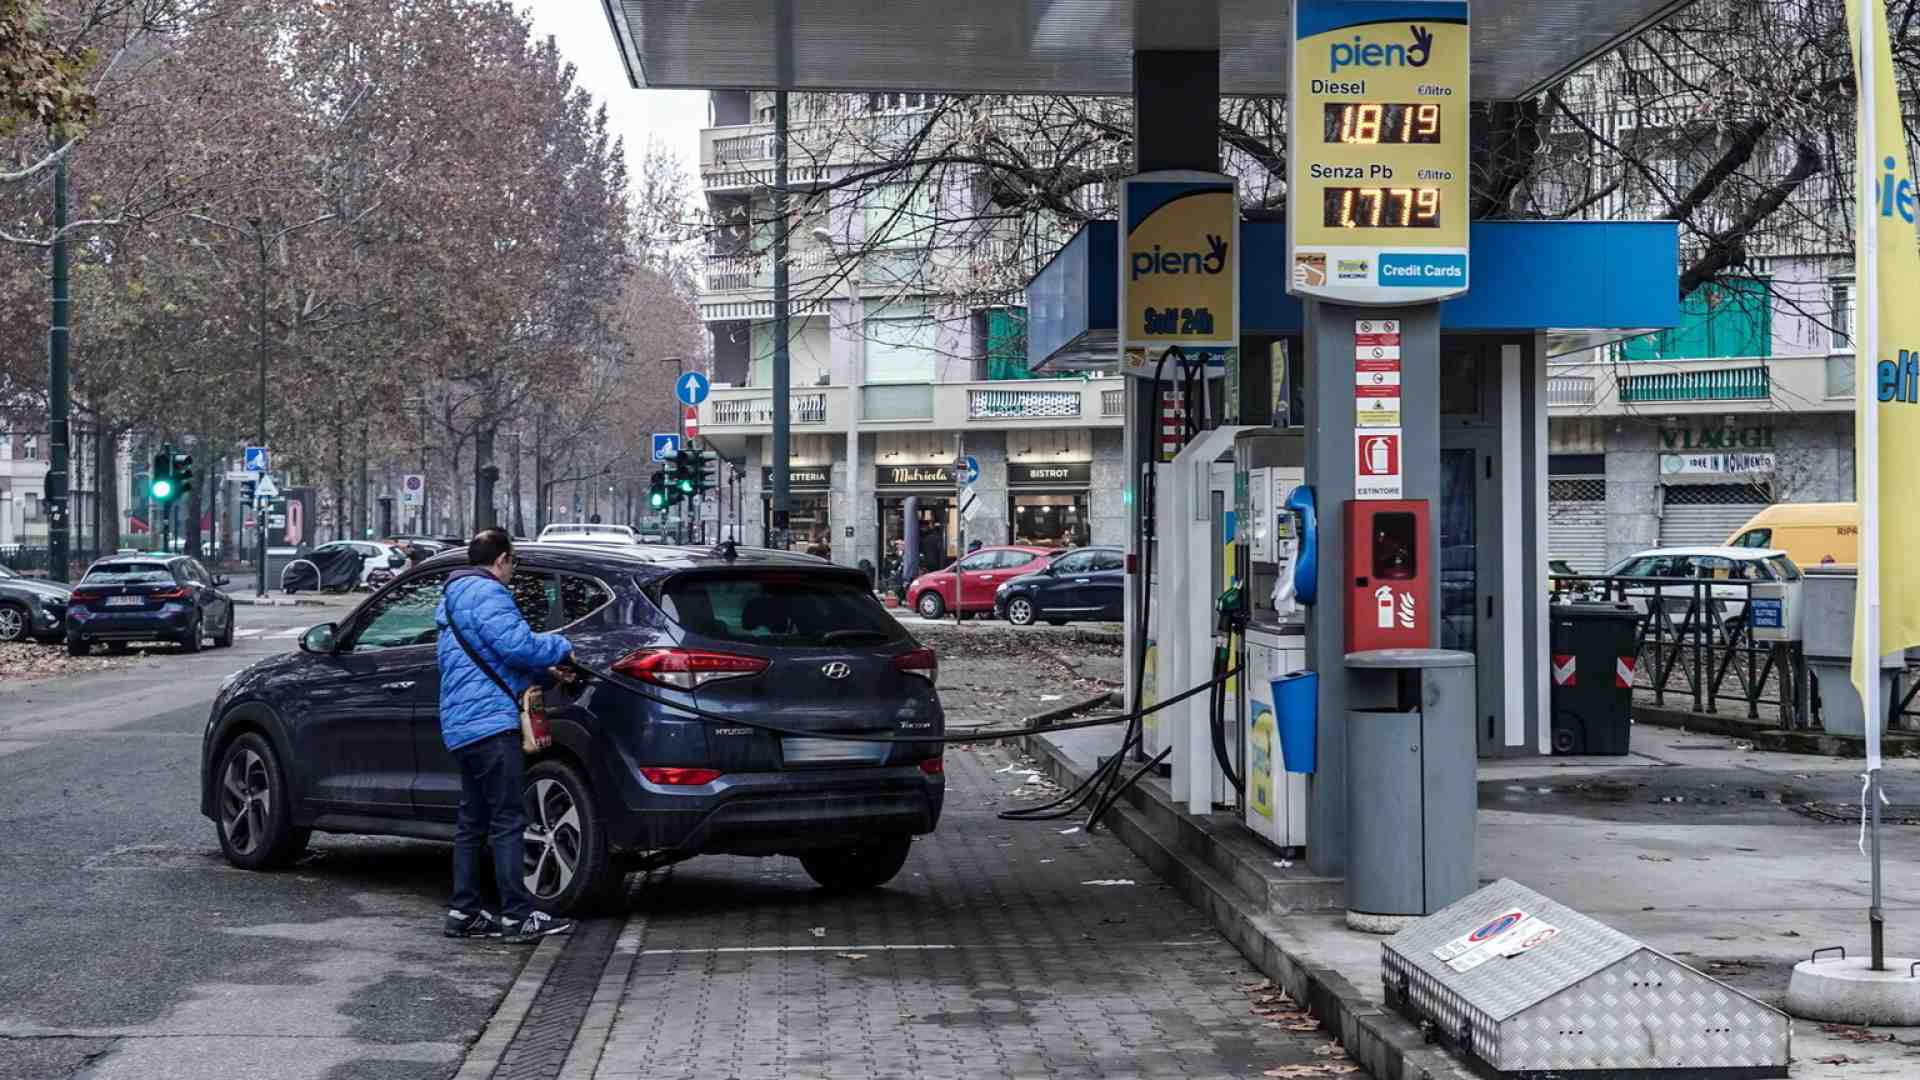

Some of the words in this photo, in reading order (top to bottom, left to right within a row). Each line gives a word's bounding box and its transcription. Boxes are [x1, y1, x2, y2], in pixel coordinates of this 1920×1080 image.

[1330, 27, 1432, 73] pieno
[1311, 80, 1365, 95] Diesel
[1310, 164, 1364, 179] Senza
[1370, 164, 1393, 179] Pb
[1876, 156, 1914, 223] ie
[1131, 235, 1228, 281] pieno
[1383, 264, 1421, 276] Credit
[1424, 264, 1462, 276] Cards
[1877, 349, 1919, 403] elf
[1660, 426, 1775, 449] VIAGGI
[891, 468, 948, 483] Matricola
[1029, 469, 1069, 478] BISTROT
[1357, 487, 1400, 495] ESTINTORE
